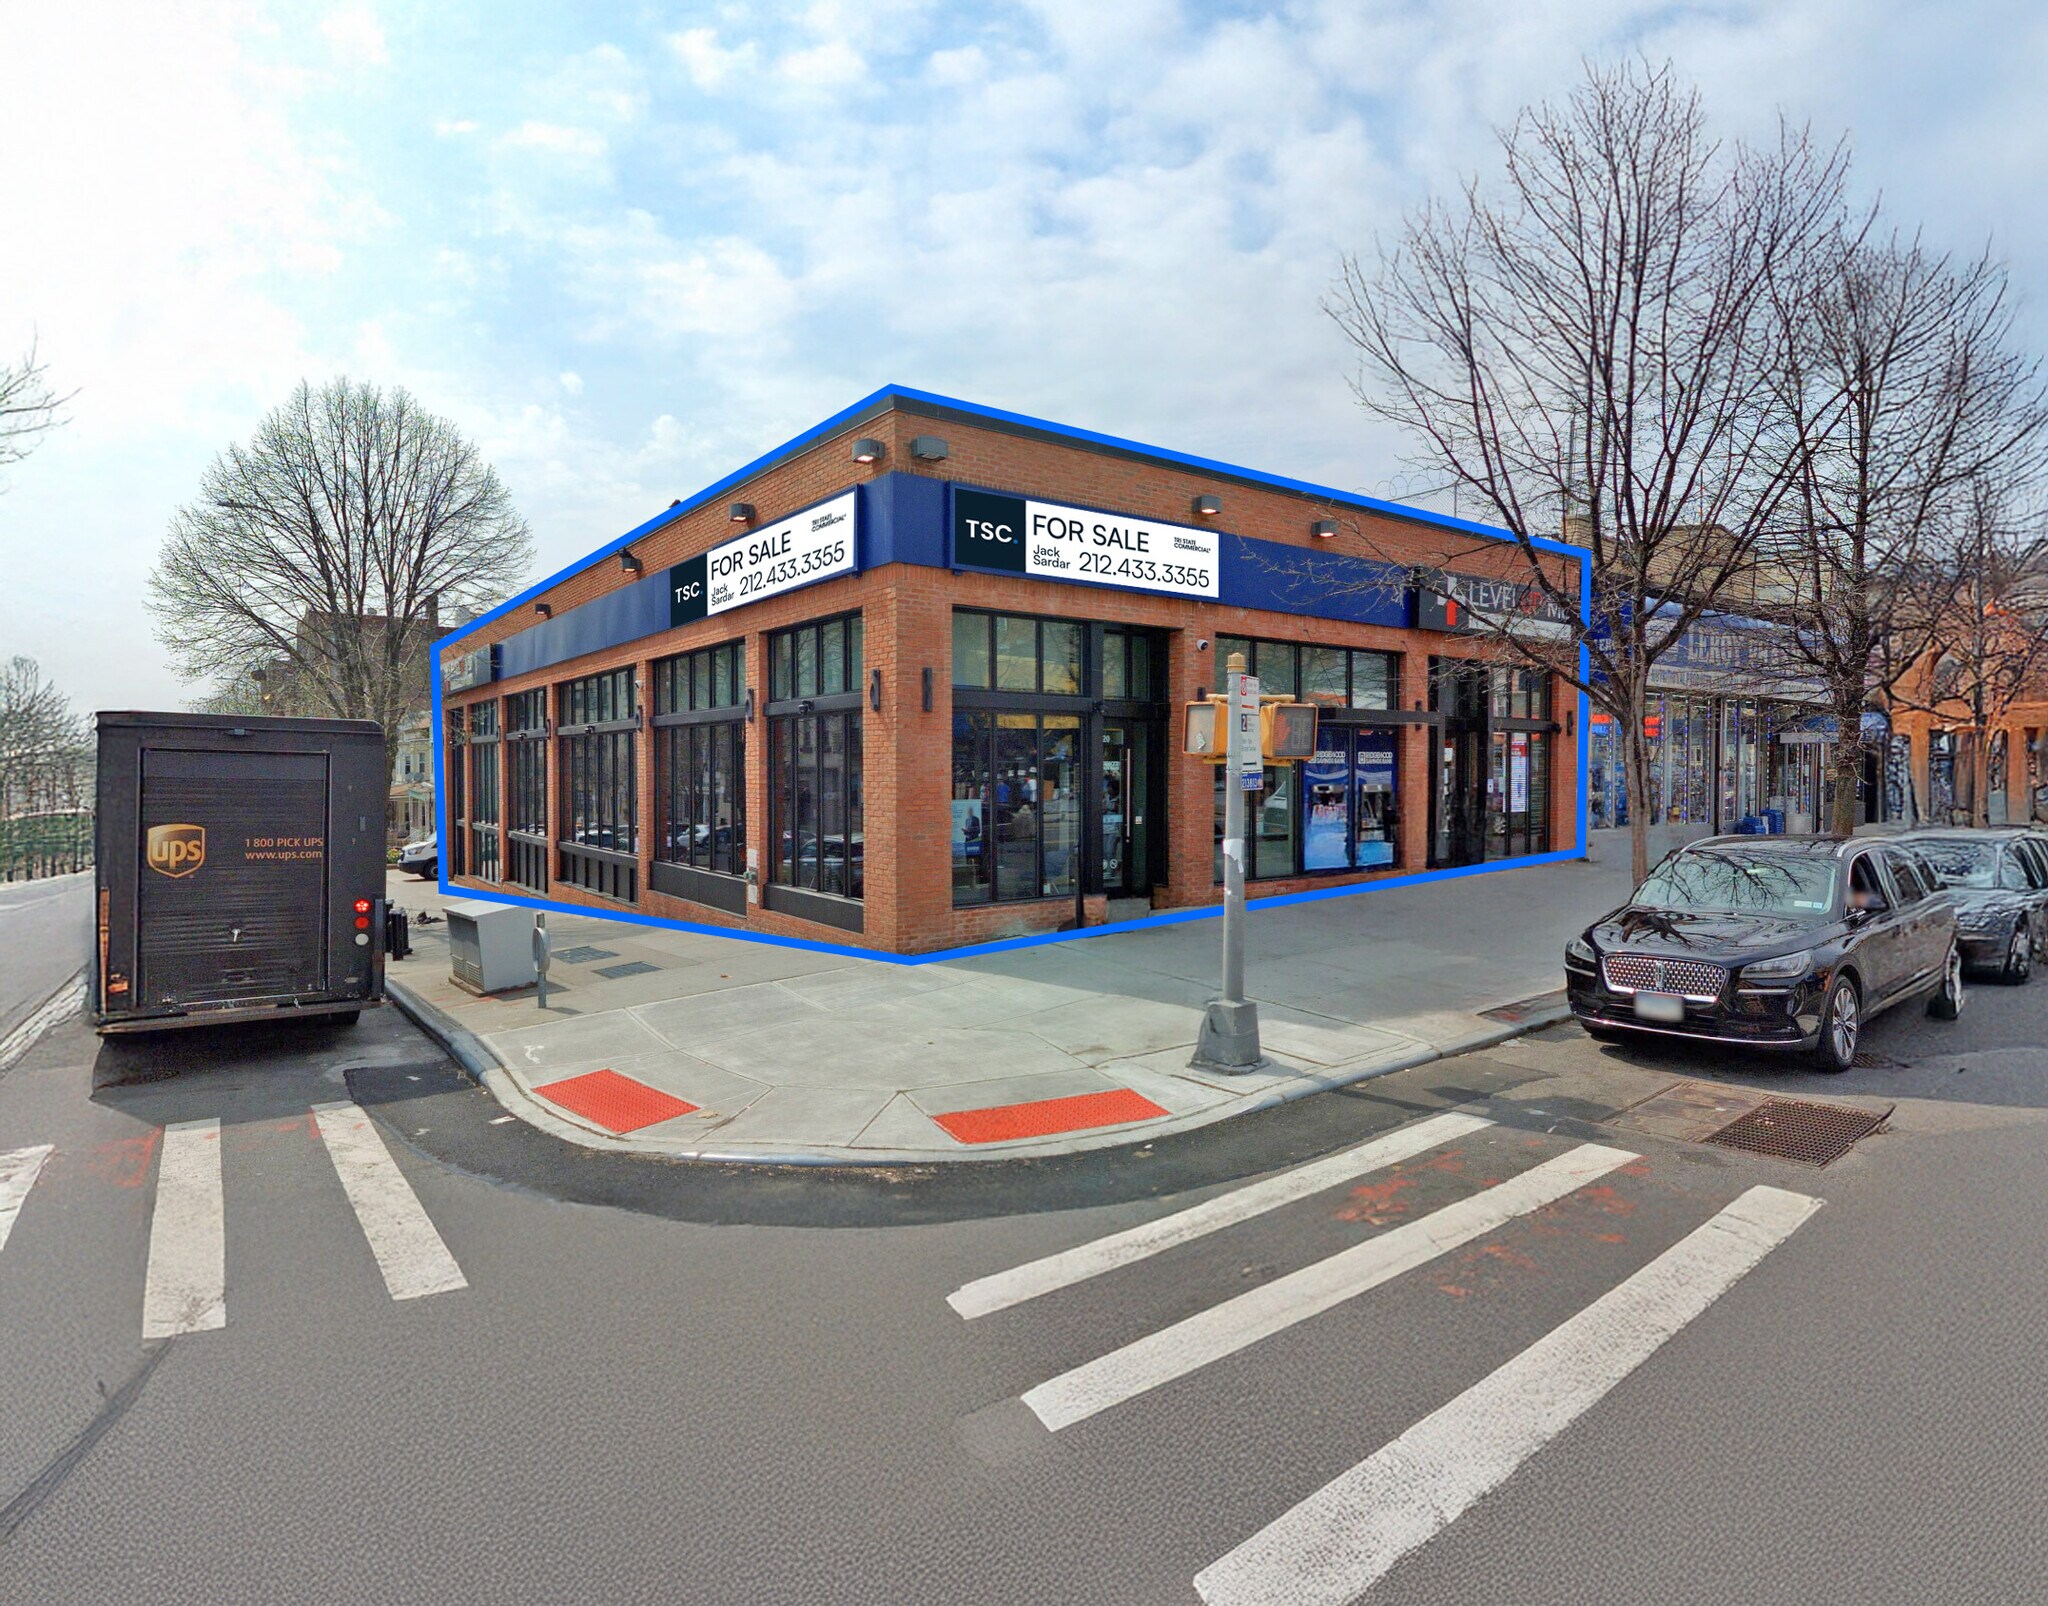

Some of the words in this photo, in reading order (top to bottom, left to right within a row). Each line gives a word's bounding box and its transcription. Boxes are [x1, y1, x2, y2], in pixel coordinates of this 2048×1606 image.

[1033, 514, 1083, 542] FOR
[1092, 524, 1149, 552] SALE
[711, 551, 743, 580] FOR
[749, 530, 791, 565] SALE
[1033, 544, 1060, 558] Jack
[740, 541, 844, 596] 212.433.3355
[1033, 555, 1070, 569] Sardar
[1079, 552, 1209, 588] 212.433.3355
[711, 583, 728, 597] Jack
[711, 592, 735, 607] Sardar
[254, 838, 273, 847] 800
[277, 838, 300, 847] PICK
[304, 837, 323, 847] UPS
[152, 840, 202, 869] ups
[245, 851, 322, 860] www.ups.com
